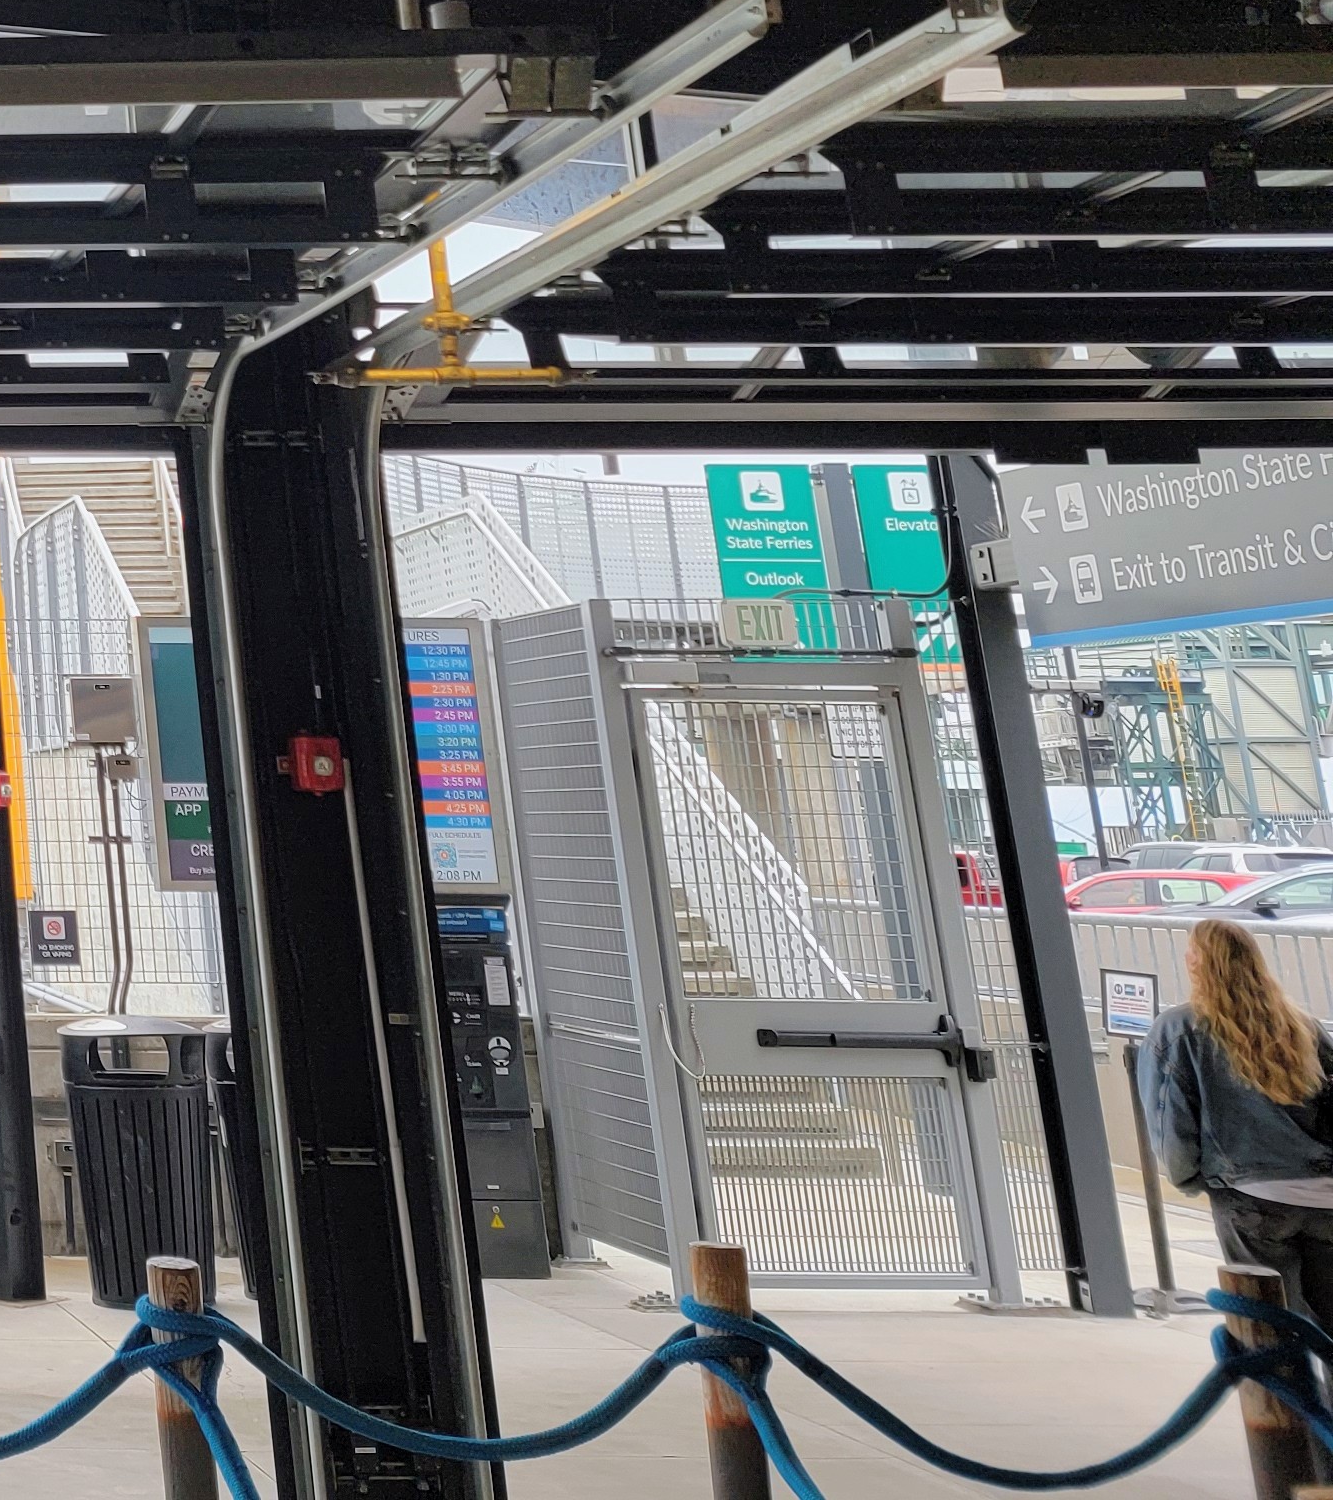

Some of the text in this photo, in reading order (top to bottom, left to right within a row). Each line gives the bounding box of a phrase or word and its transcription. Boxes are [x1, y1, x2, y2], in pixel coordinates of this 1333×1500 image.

[1096, 467, 1240, 517] Washington
[1242, 453, 1313, 490] State
[725, 518, 809, 534] Washington
[726, 536, 813, 550] State Ferries
[1110, 553, 1157, 591] Exit
[1160, 552, 1186, 584] to
[1188, 534, 1278, 579] Transit
[1283, 528, 1307, 566] &
[745, 571, 805, 586] Outlook
[735, 605, 784, 641] EXIT
[407, 631, 440, 642] URES
[422, 646, 466, 655] 12:30 PM
[424, 659, 468, 668] 12:45 PM
[431, 672, 469, 681] 1:30 PM
[432, 685, 471, 694] 2:25 PM
[434, 698, 472, 707] 2:30 PM
[435, 711, 474, 720] 2:45 PM
[437, 724, 476, 733] 3:00 PM
[438, 737, 477, 746] 3:20 PM
[439, 750, 478, 760] 3:25 PM
[441, 764, 480, 773] 3:45 PM
[442, 777, 482, 787] 3:55 PM
[170, 786, 205, 798] PAYM
[444, 790, 483, 800] 4:05 PM
[175, 803, 202, 816] APP
[445, 804, 485, 813] 4:25 PM
[447, 817, 487, 827] 4:30 PM
[436, 870, 482, 881] 2:08 PM
